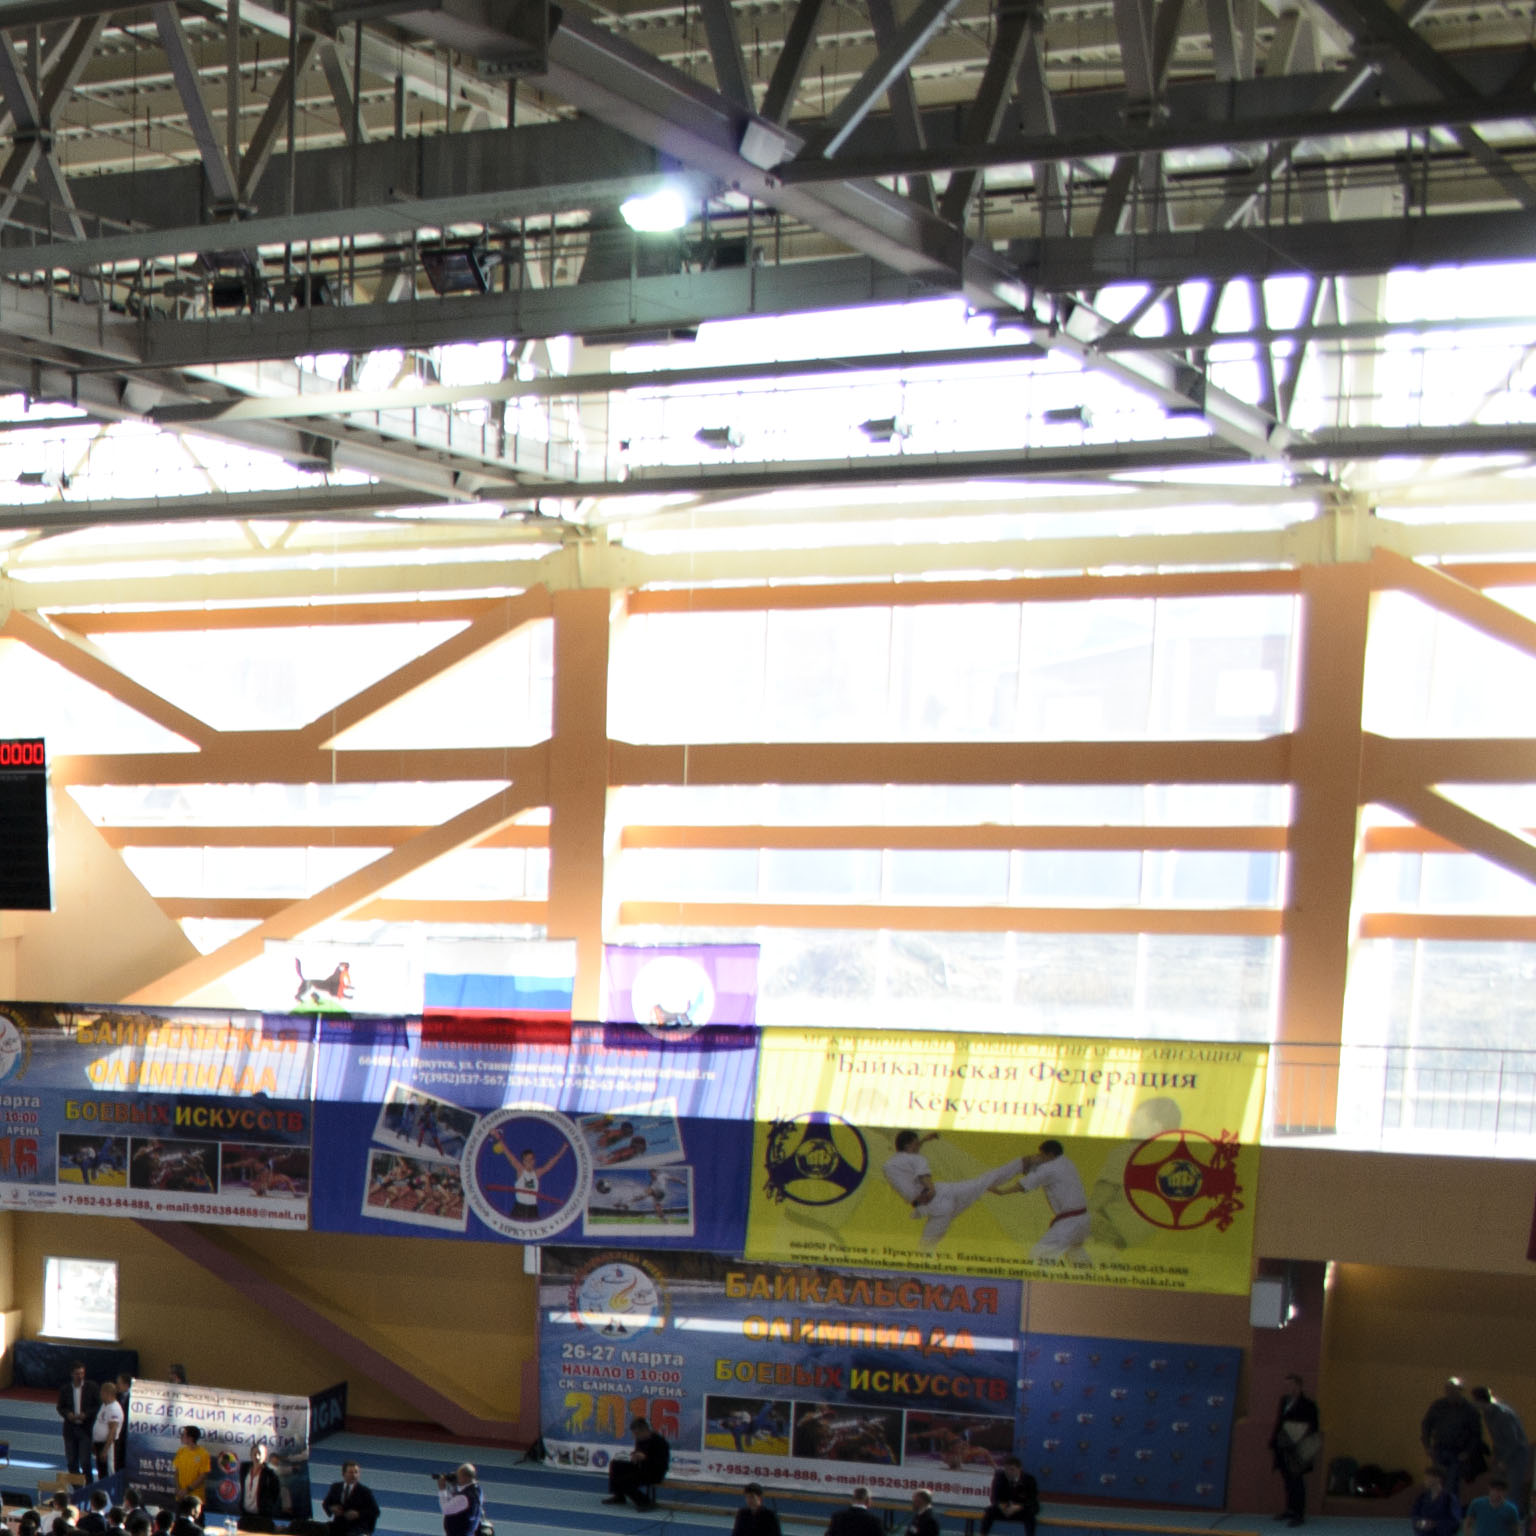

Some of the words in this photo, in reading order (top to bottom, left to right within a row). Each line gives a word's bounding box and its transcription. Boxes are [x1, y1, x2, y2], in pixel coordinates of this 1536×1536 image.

[76, 1018, 298, 1055] БАЙКАЛЬСКАЯ
[88, 1058, 278, 1094] ОЛИМПИАДА
[1029, 1064, 1198, 1093] Федерация
[5, 1111, 38, 1124] 10:00
[65, 1100, 170, 1124] БОЕВЫХ
[175, 1106, 304, 1131] ИСКУССТВ
[882, 1246, 932, 1259] Иркутск
[956, 1252, 1034, 1266] Байкальская
[724, 1268, 999, 1316] БАЙКАЛЬСКАЯ
[742, 1314, 976, 1360] ОЛИМПИАДА
[561, 1342, 616, 1362] 26-27
[620, 1350, 685, 1368] марта
[558, 1379, 575, 1390] СК
[561, 1363, 622, 1379] НАЧАЛО
[639, 1370, 682, 1383] 10:00
[714, 1358, 843, 1389] БОЕВЫХ
[849, 1368, 1009, 1401] ИСКУССТВ
[130, 1400, 226, 1423] ФЕДЕРАЦИЯ
[232, 1411, 289, 1429] КАРАТЭ
[129, 1420, 218, 1440] ИРКУТСОЙ
[224, 1430, 296, 1448] ОБЛАСТИ
[824, 1473, 992, 1497] e-mail:9526384888@mail
